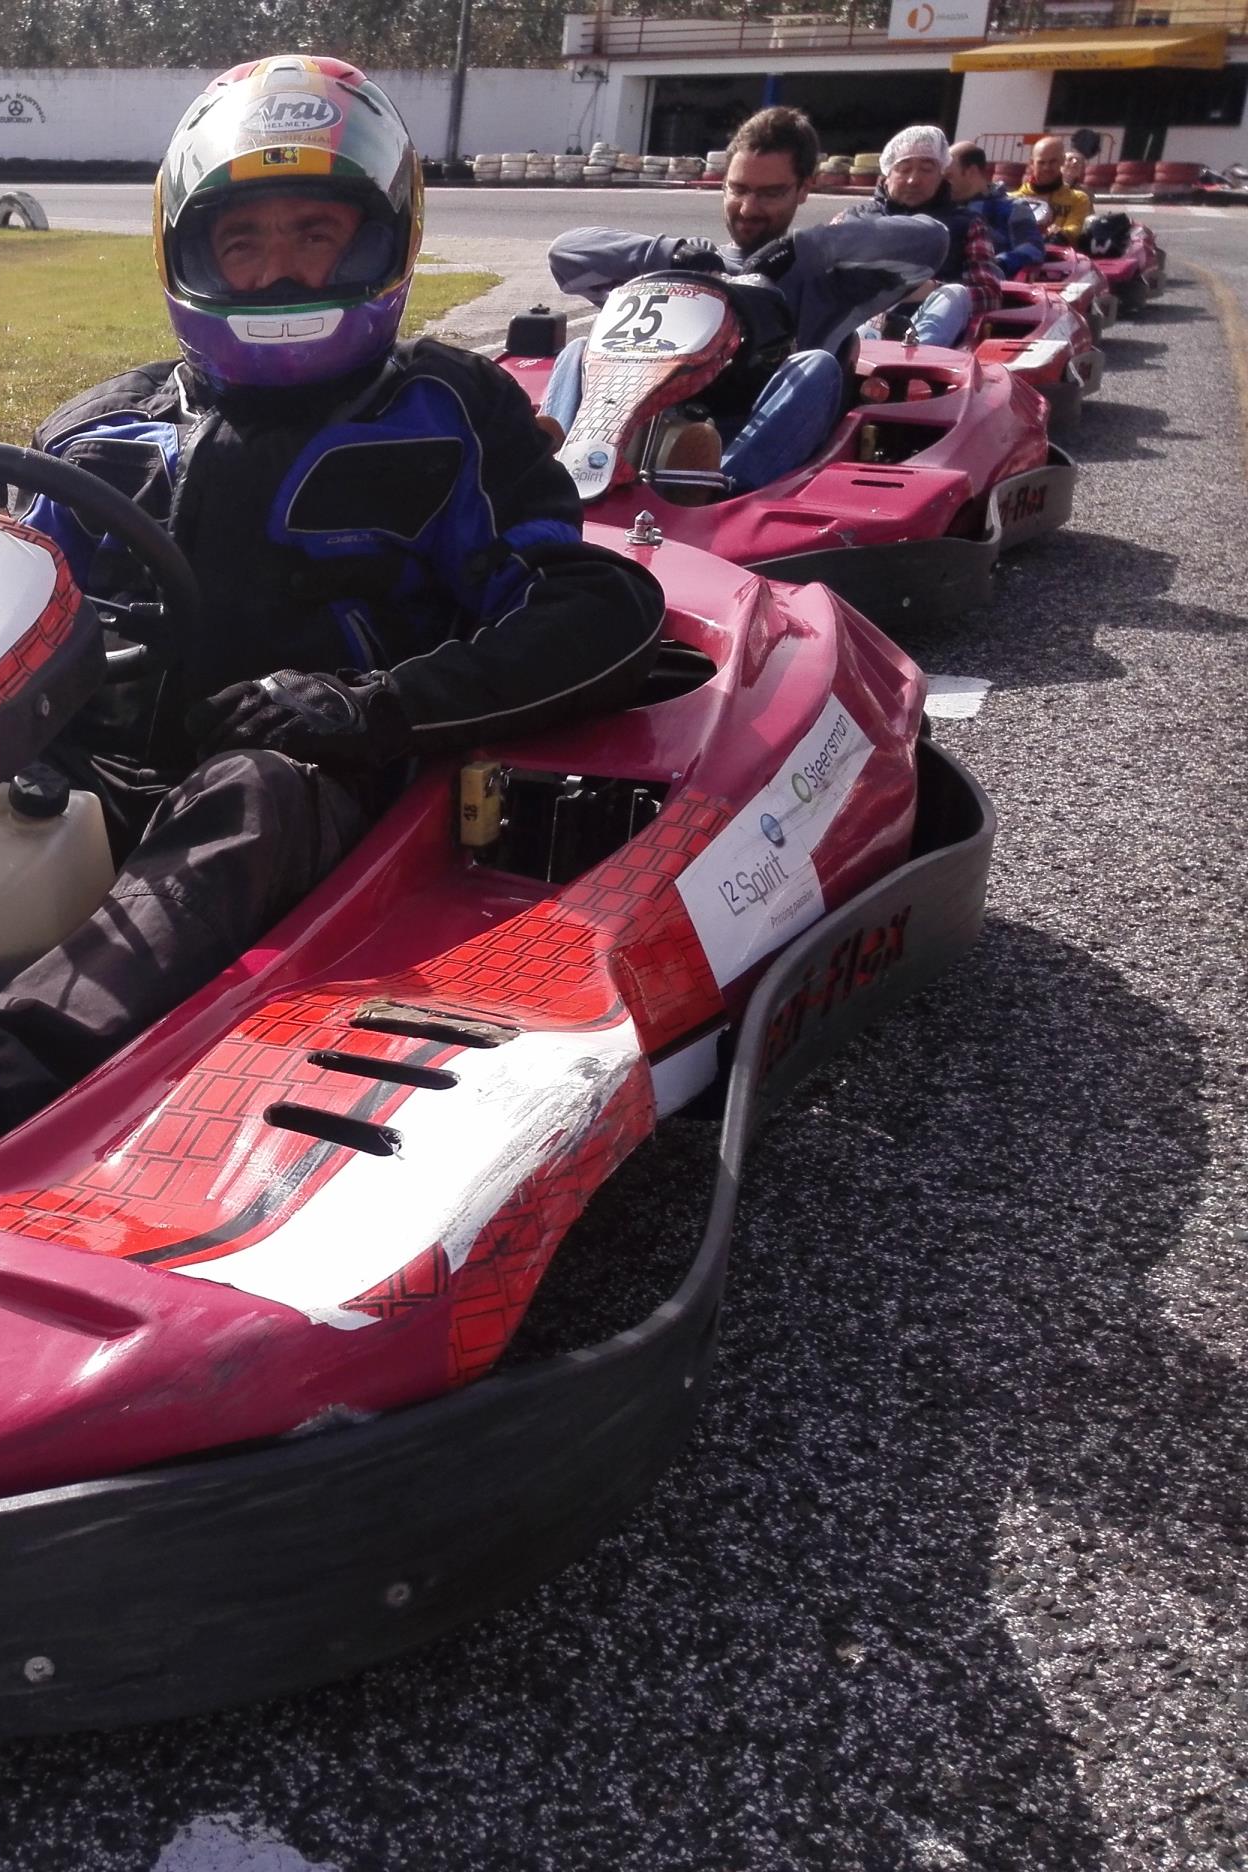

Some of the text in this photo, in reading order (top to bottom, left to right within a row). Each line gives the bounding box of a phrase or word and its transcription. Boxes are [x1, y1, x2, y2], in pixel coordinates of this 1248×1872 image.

[250, 95, 331, 121] Arai
[602, 295, 670, 340] 25
[804, 713, 852, 789] Steersman
